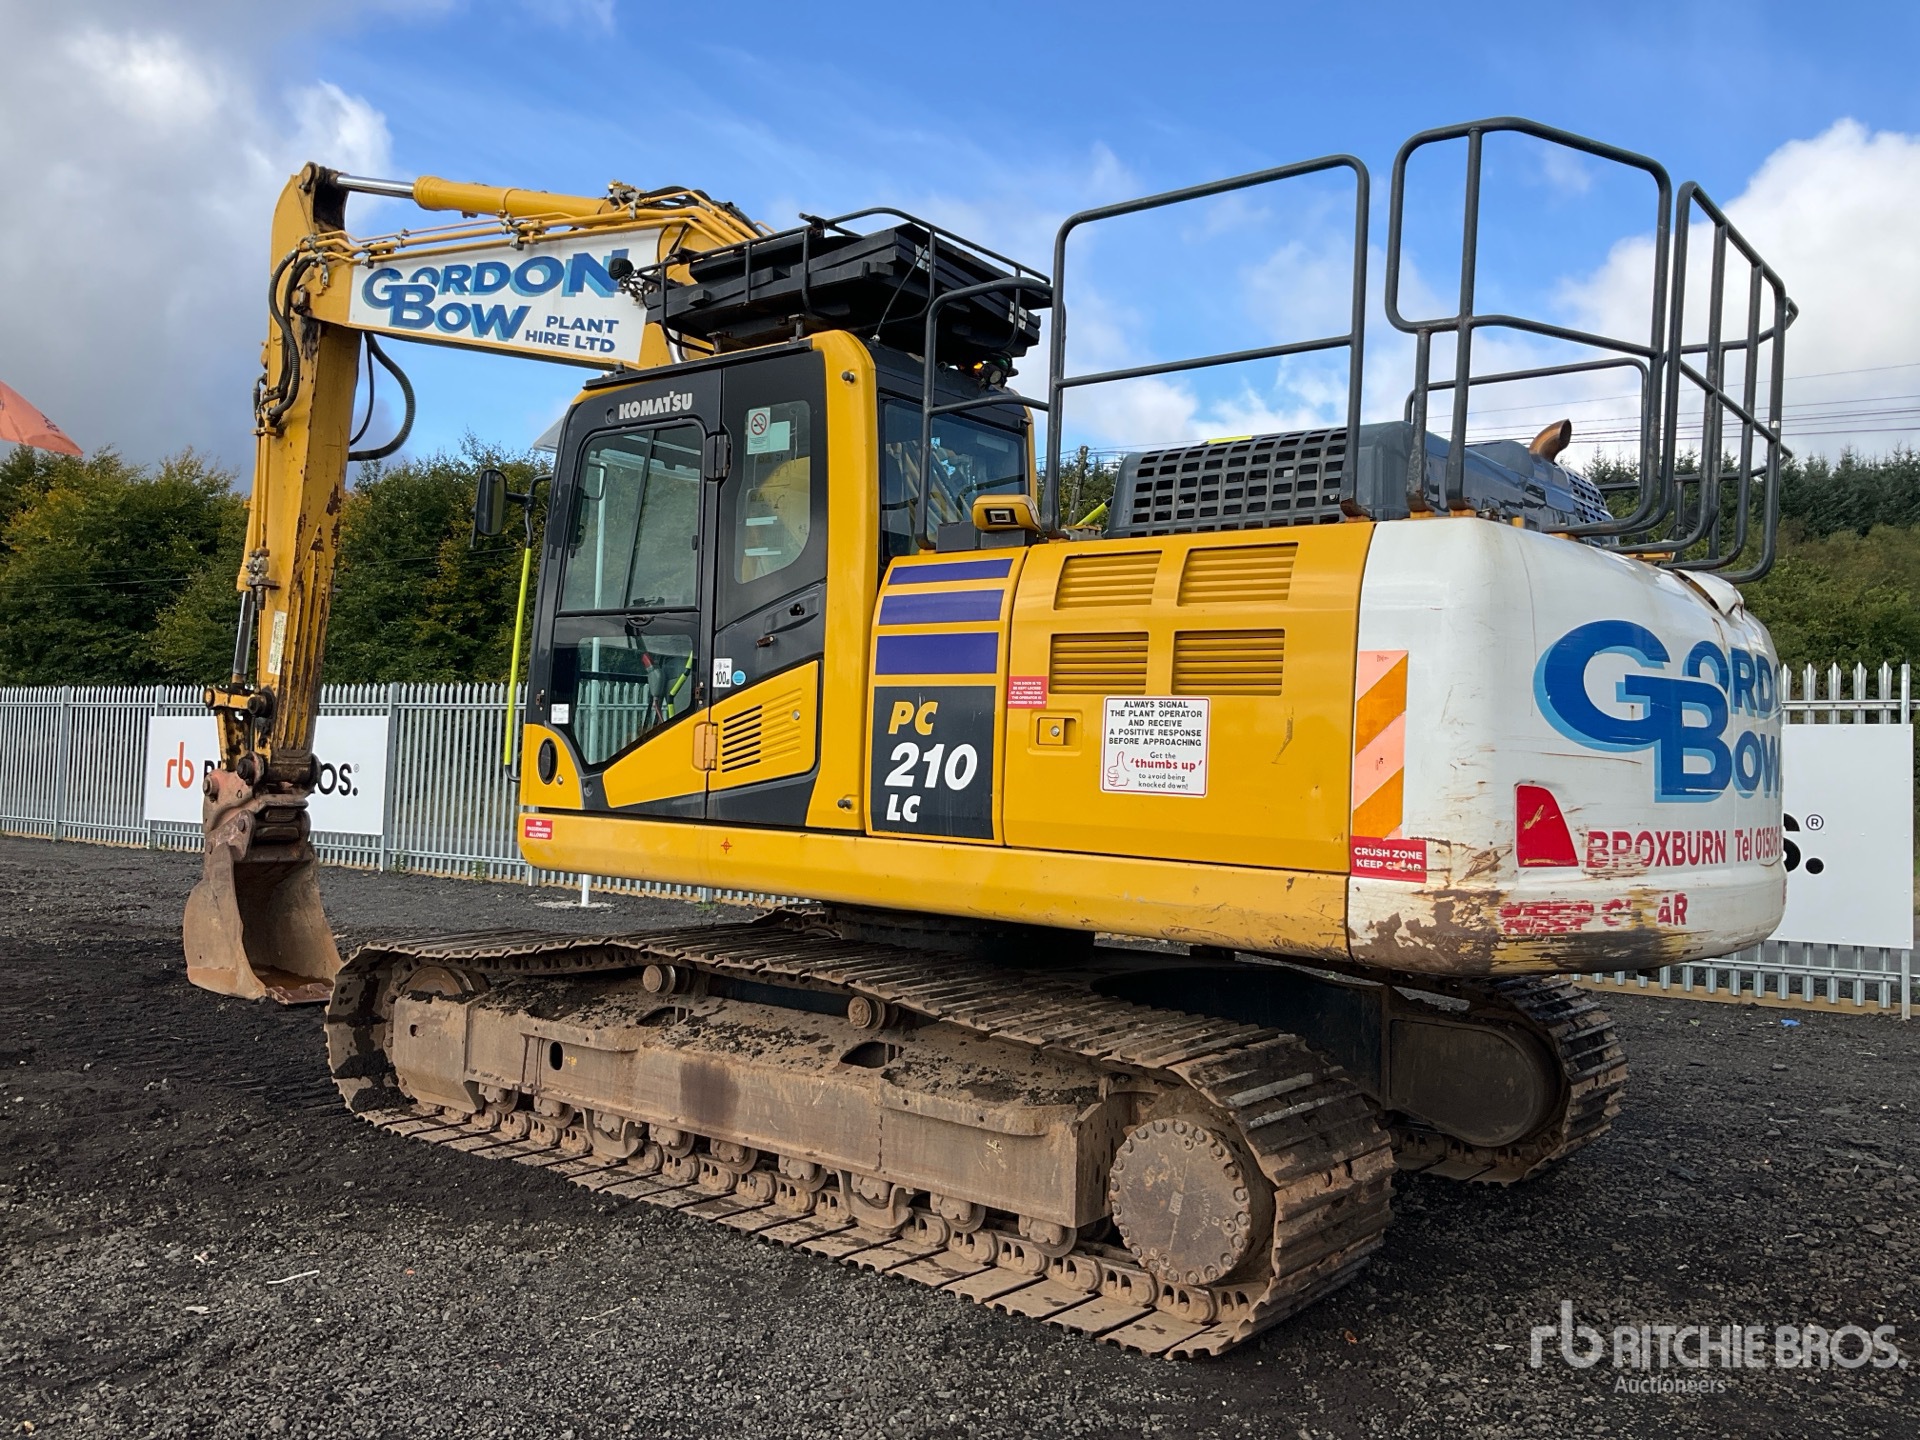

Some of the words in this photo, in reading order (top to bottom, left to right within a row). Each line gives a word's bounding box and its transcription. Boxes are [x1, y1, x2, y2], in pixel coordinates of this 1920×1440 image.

[362, 249, 630, 309] GORDON
[382, 284, 532, 342] BOW
[546, 316, 619, 334] PLANT
[525, 330, 569, 347] HIRE
[575, 335, 615, 353] LTD
[619, 391, 693, 419] KOMATSU
[888, 702, 938, 735] PC
[1159, 710, 1202, 718] OPERATOR
[1143, 738, 1201, 746] APPROACHING
[166, 741, 195, 789] rb
[884, 742, 977, 791] 210
[1168, 774, 1186, 782] being
[886, 794, 921, 823] LC
[1354, 847, 1390, 858] CRUSH
[1392, 850, 1423, 860] ZONE
[1586, 829, 1726, 868] BROXBURN
[1735, 828, 1752, 862] Tel
[1356, 859, 1383, 869] KEEP
[1385, 861, 1422, 872] CAR
[1601, 893, 1688, 928] CAR
